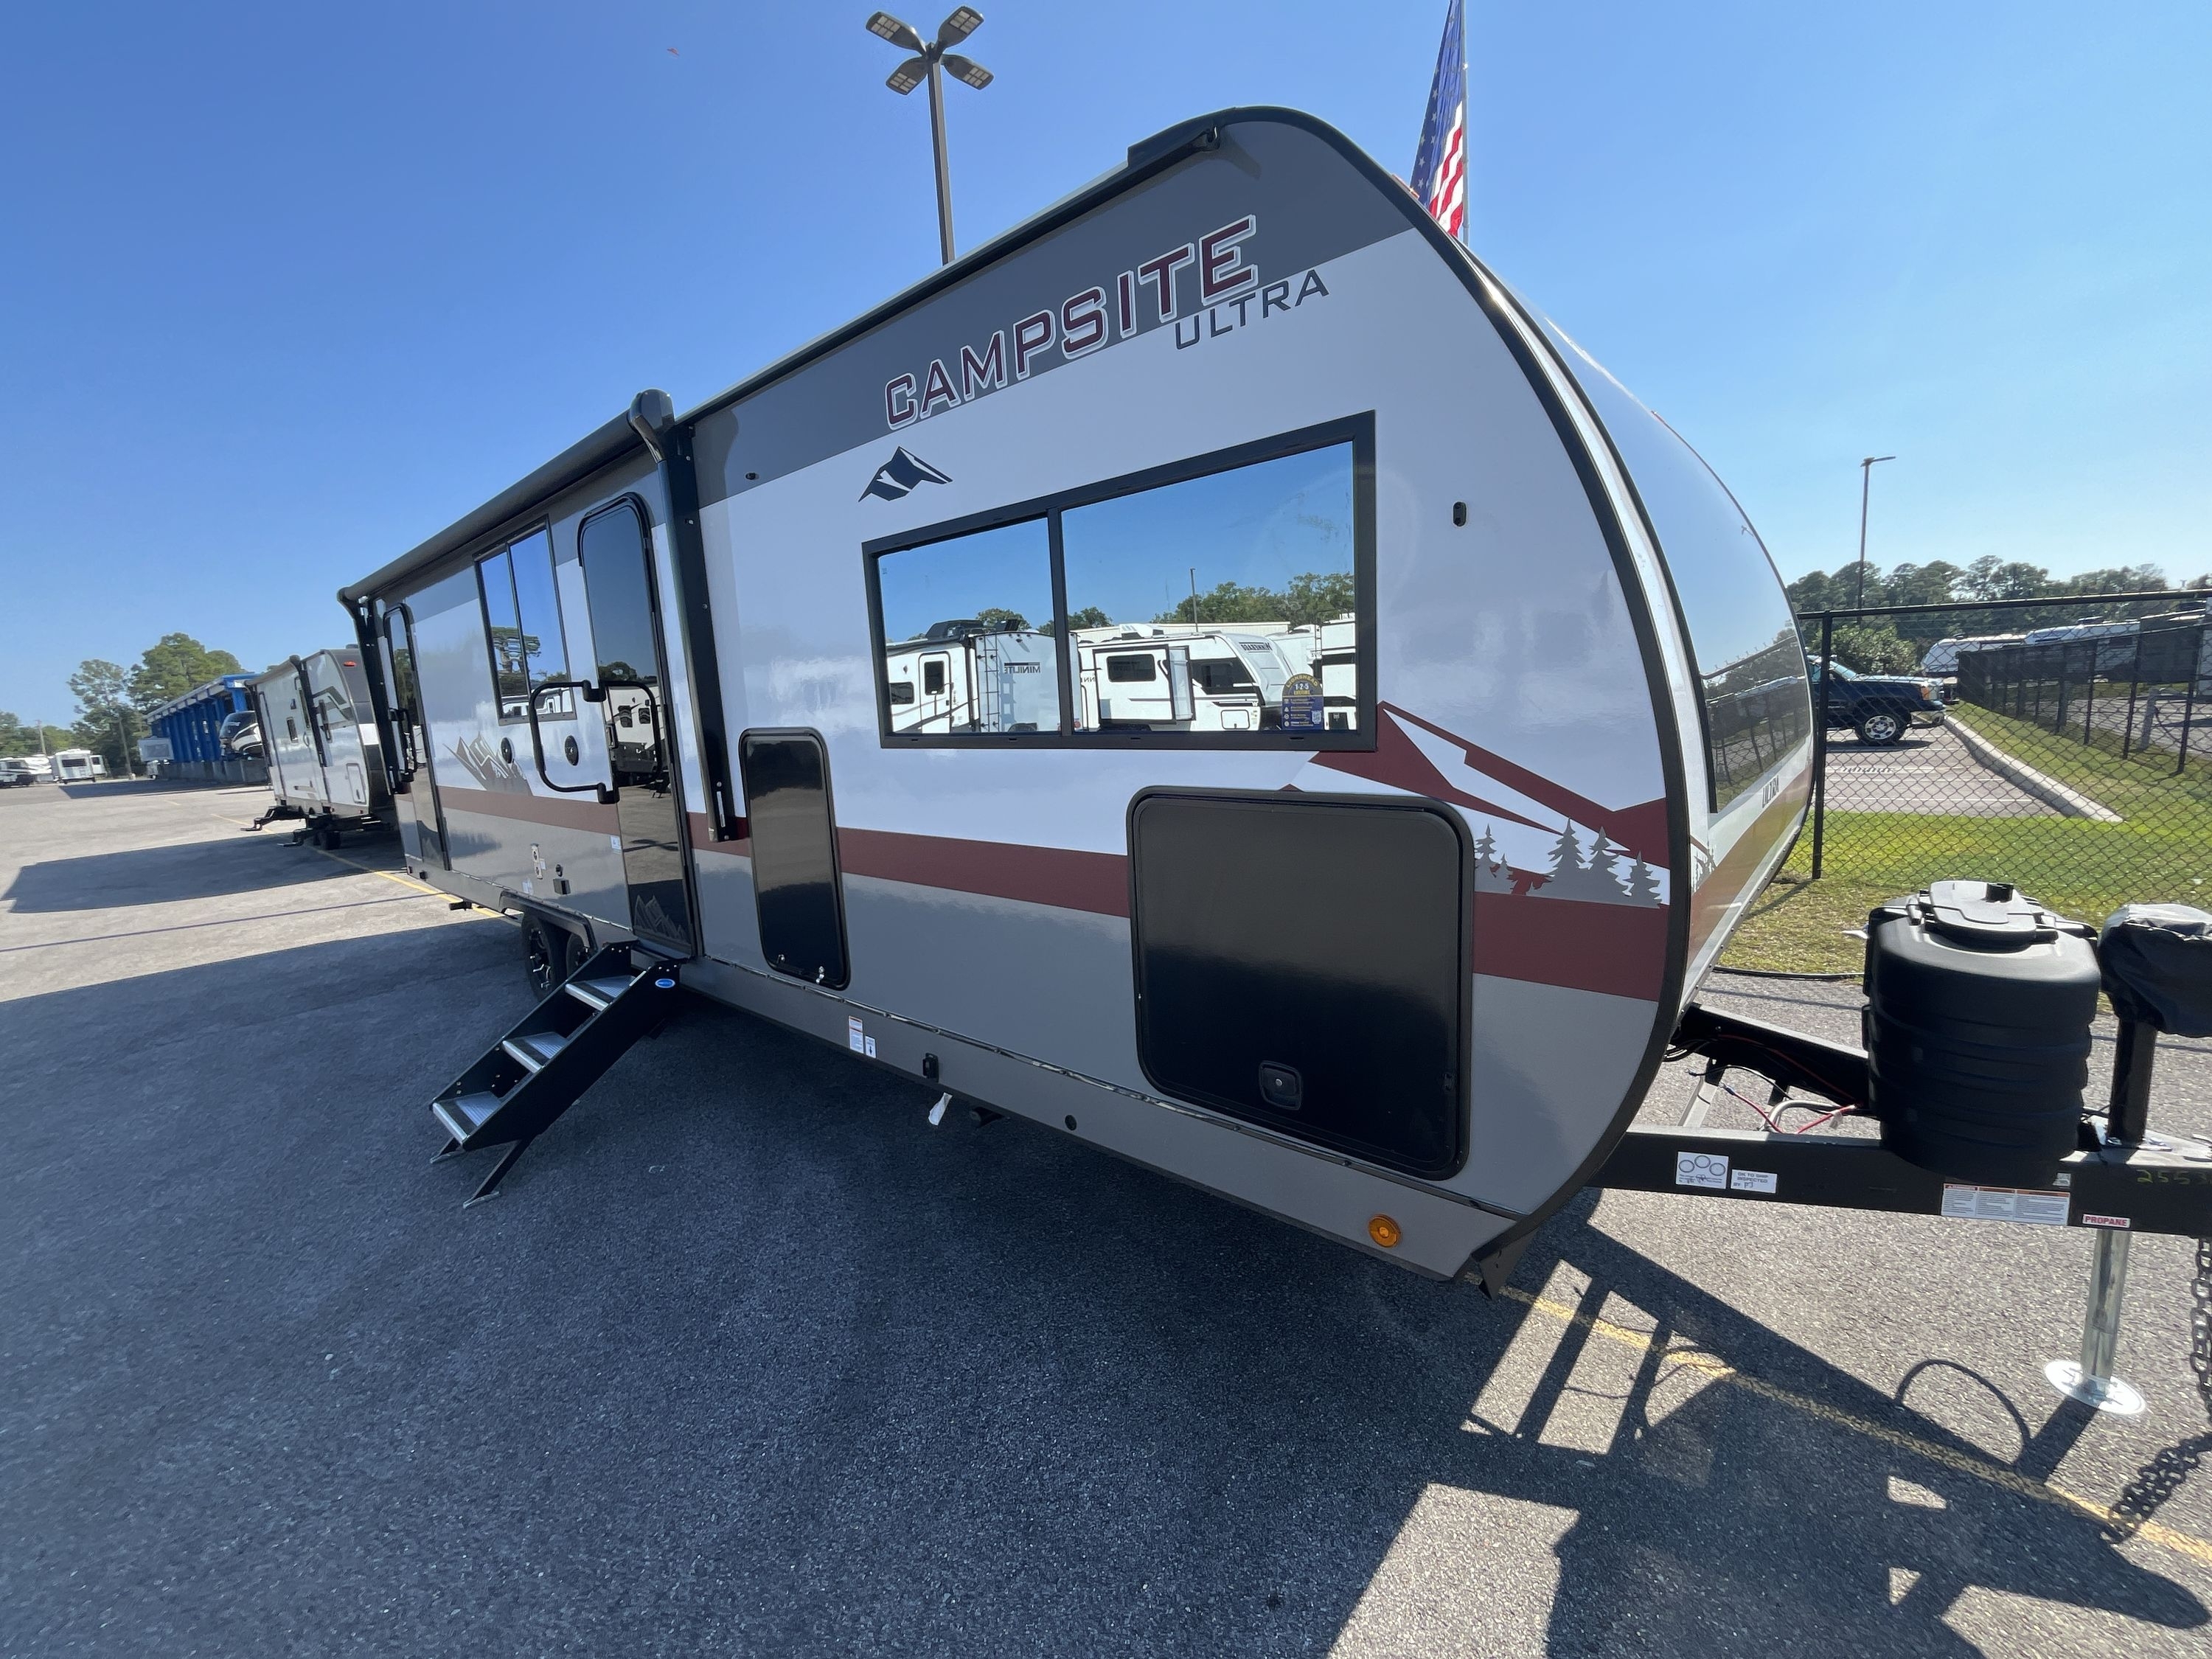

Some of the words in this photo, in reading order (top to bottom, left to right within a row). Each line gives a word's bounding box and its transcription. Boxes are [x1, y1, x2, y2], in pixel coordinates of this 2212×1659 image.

[885, 214, 1258, 430] CAMPSITE
[1175, 268, 1329, 350] ULTRA
[1286, 674, 1318, 688] LIONSHEAD
[1762, 775, 1778, 809] ULTRA
[2084, 1216, 2128, 1227] PROPANE
